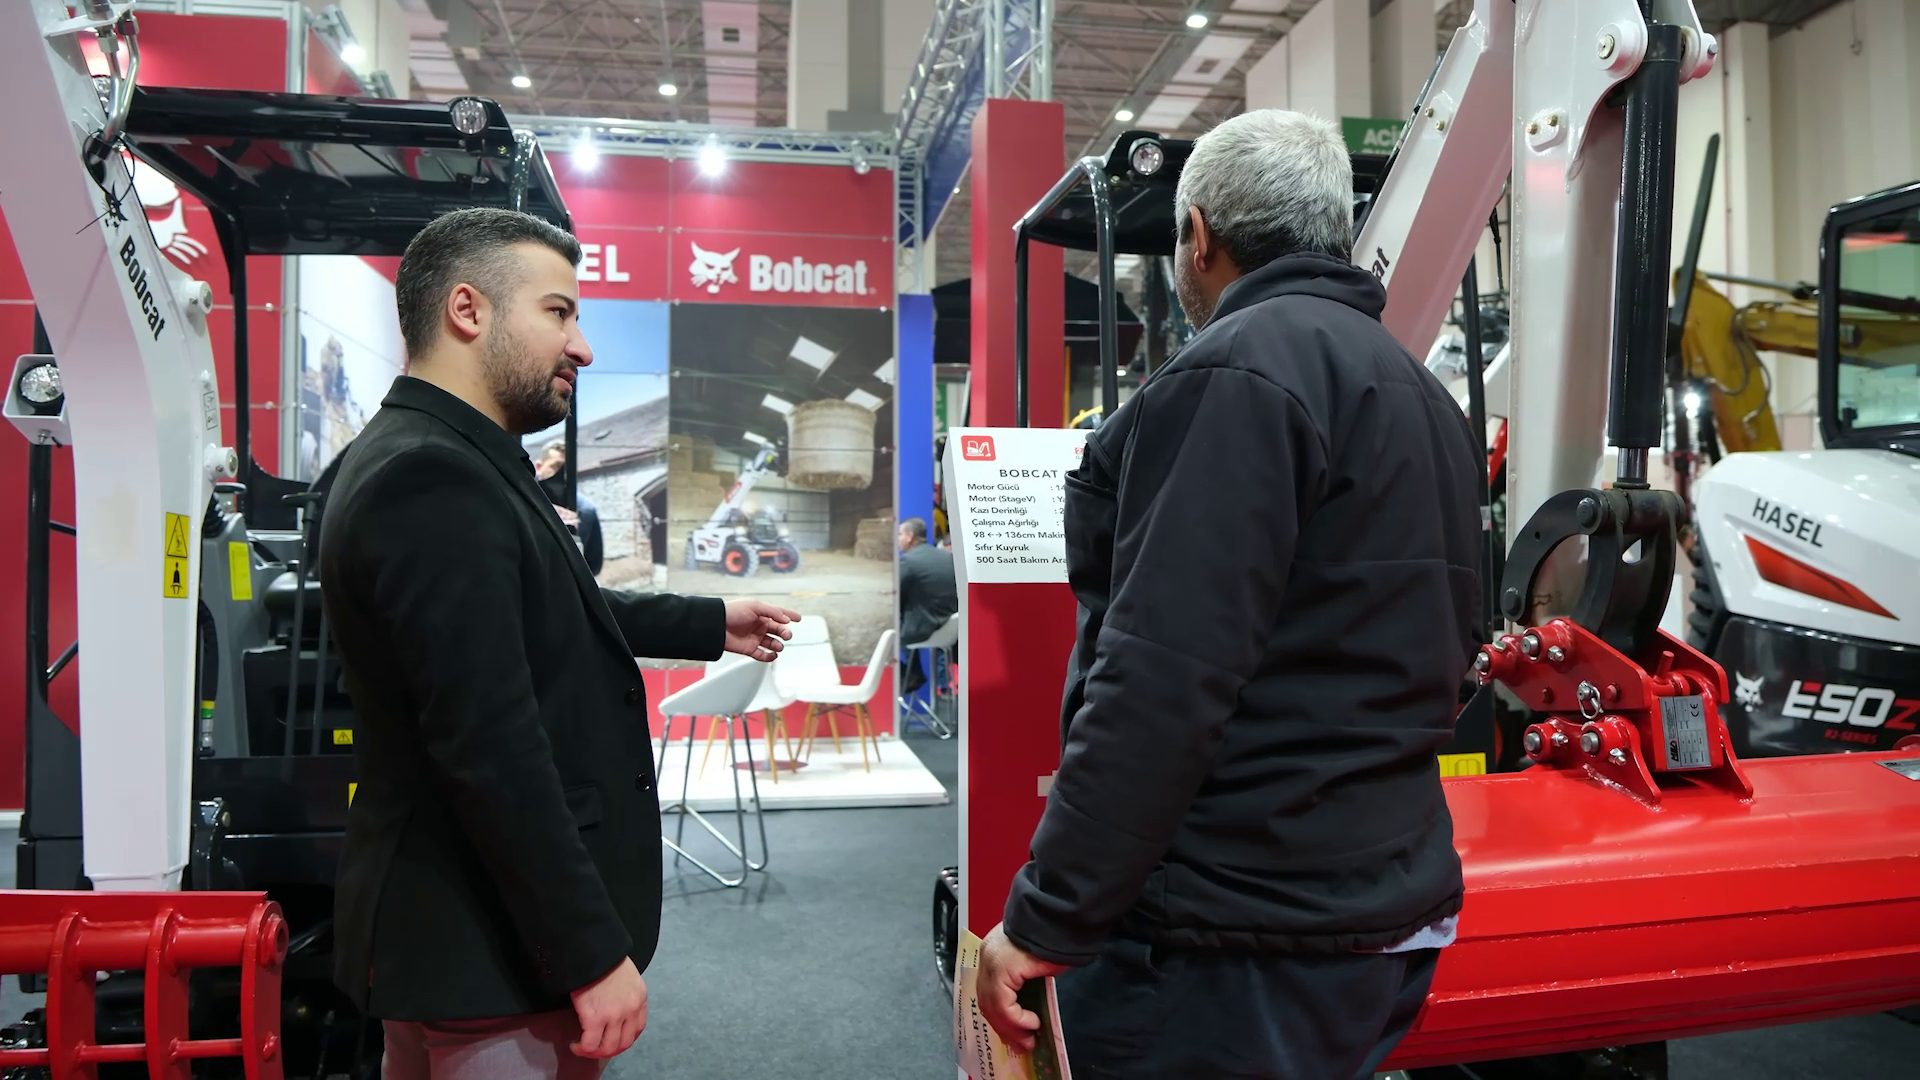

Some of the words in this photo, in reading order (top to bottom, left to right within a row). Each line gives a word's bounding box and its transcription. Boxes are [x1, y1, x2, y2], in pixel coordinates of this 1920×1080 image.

[749, 254, 868, 295] Bobcat
[120, 235, 165, 342] Bobcat
[999, 469, 1058, 479] BOBCAT
[967, 483, 995, 491] Motor
[997, 483, 1020, 491] Gücü
[998, 495, 1036, 504] (StageV)
[991, 506, 1028, 516] Derinliği
[971, 518, 1006, 528] Çalışma
[1007, 518, 1039, 528] Ağırlığı
[1752, 497, 1824, 548] HASEL
[974, 543, 994, 551] Sıfır
[995, 543, 1030, 553] Kuyruk
[976, 556, 995, 564] 500
[997, 556, 1018, 564] Saat
[1020, 555, 1049, 564] Bakım
[970, 998, 979, 1031] RTK
[982, 1023, 995, 1080] tasyon
